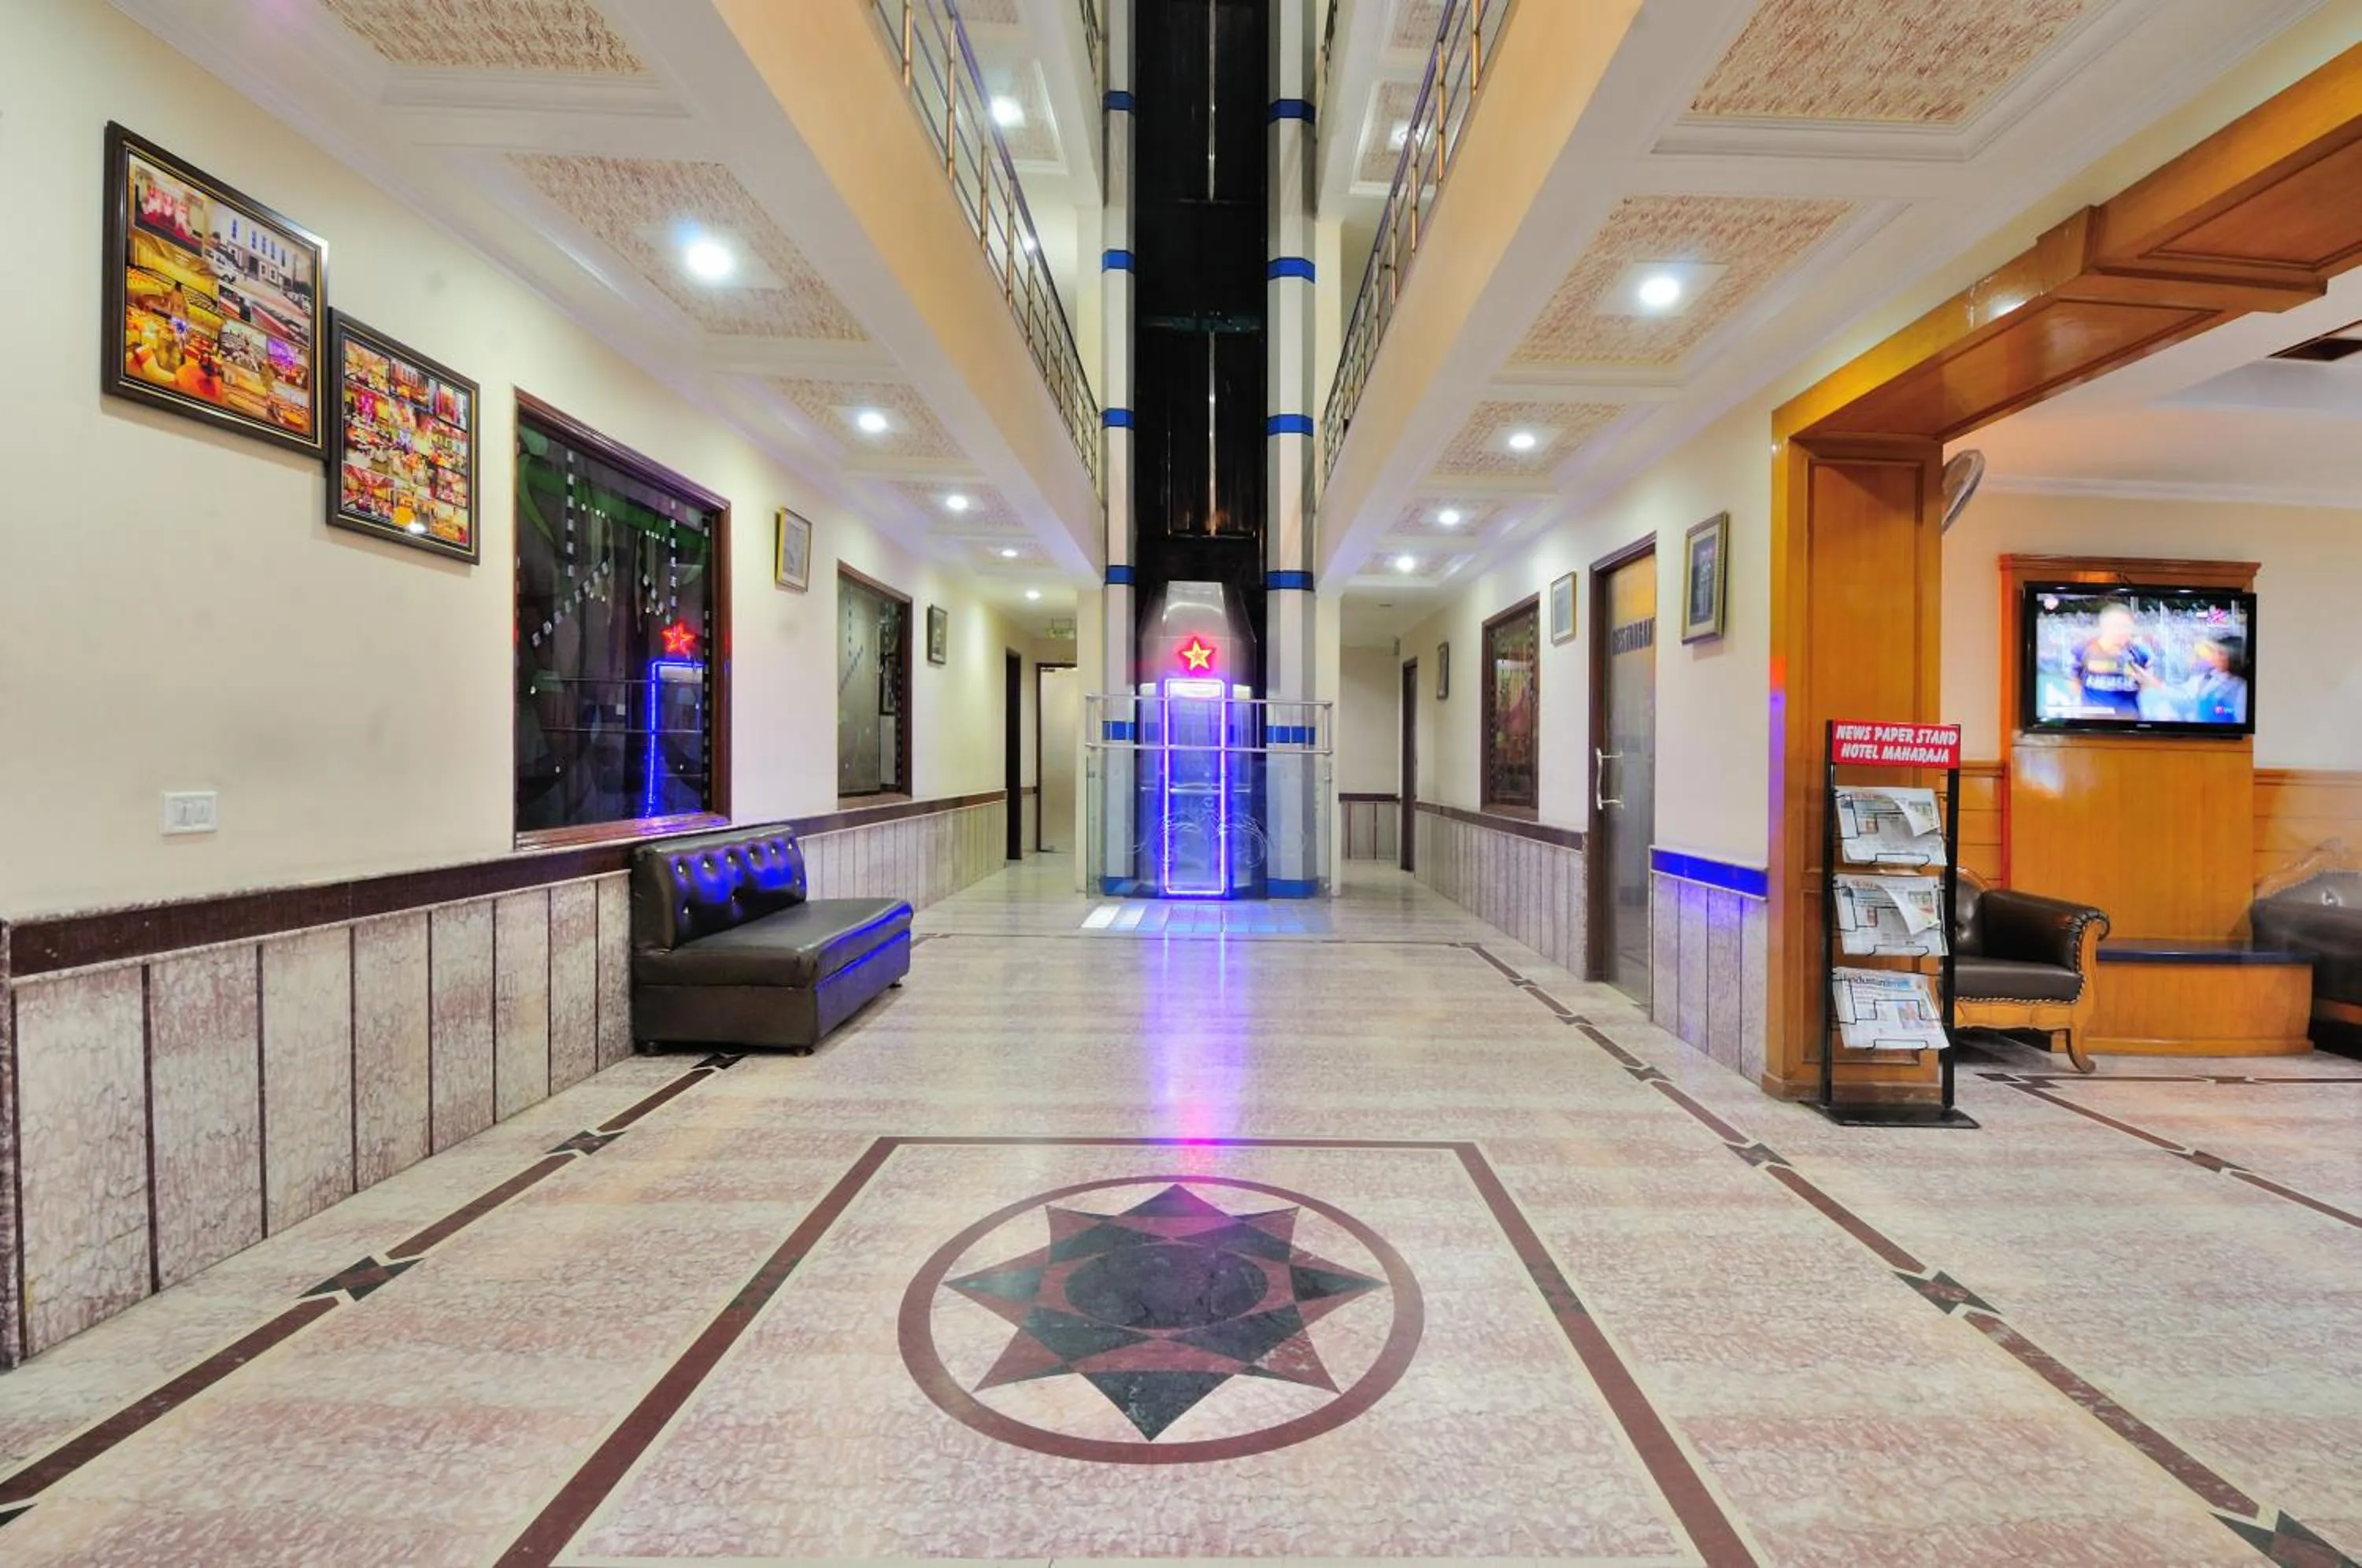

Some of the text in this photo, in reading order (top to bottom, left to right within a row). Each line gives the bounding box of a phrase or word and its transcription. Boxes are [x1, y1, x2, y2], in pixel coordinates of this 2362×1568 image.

[1836, 725, 1957, 745] NEWS PAPER STAND
[1841, 743, 1949, 763] HOTEL MAHARAJA
